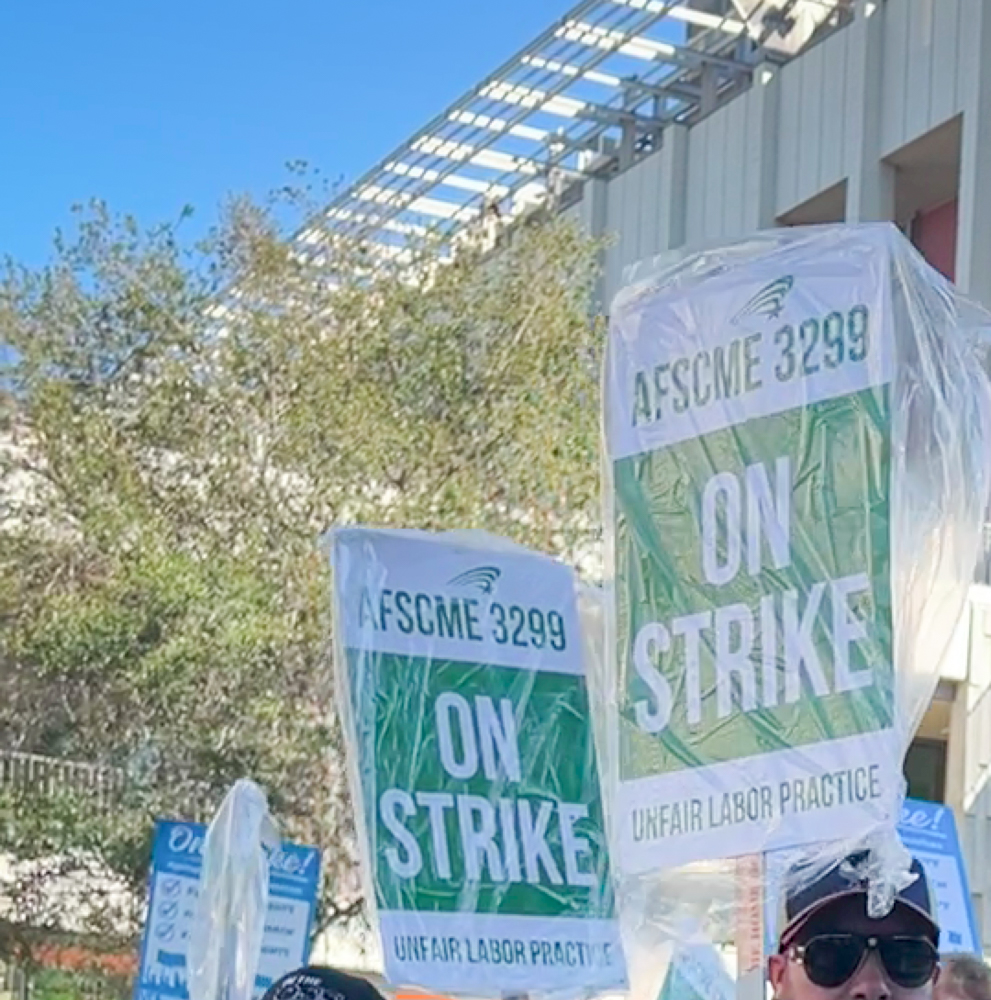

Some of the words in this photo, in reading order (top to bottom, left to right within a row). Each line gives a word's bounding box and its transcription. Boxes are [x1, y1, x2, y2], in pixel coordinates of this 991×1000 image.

[631, 333, 763, 427] AFSCME
[775, 305, 869, 383] 3299
[703, 456, 792, 586] ON
[359, 586, 483, 641] AFSCME
[490, 602, 566, 651] 3299
[633, 573, 875, 733] STRIKE
[436, 692, 518, 782] ON
[380, 789, 597, 887] STRIKE
[632, 798, 703, 842] UNFAIR
[709, 786, 773, 828] LABOR
[779, 765, 882, 815] PRACTICE
[394, 935, 462, 963] UNFAIR
[466, 938, 527, 966] LABOR
